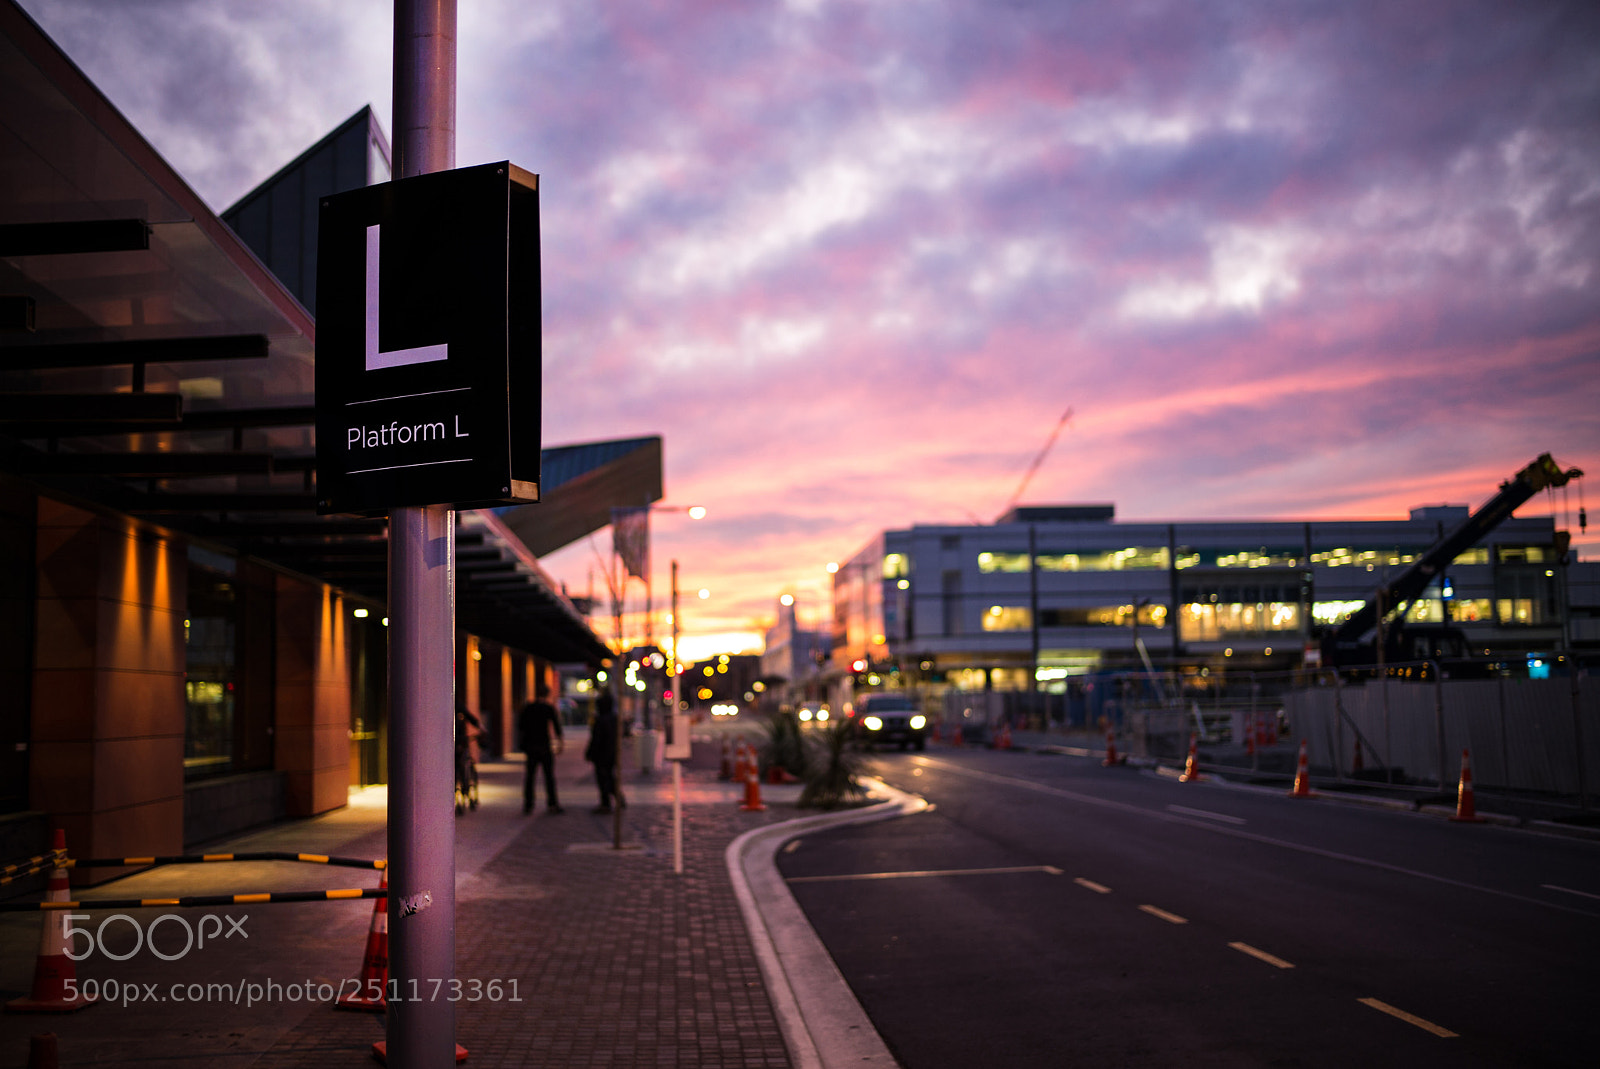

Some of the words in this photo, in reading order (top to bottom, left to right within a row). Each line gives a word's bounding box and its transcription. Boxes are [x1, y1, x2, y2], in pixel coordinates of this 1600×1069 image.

[365, 224, 448, 371] L
[347, 421, 445, 450] Platform
[455, 414, 469, 438] L
